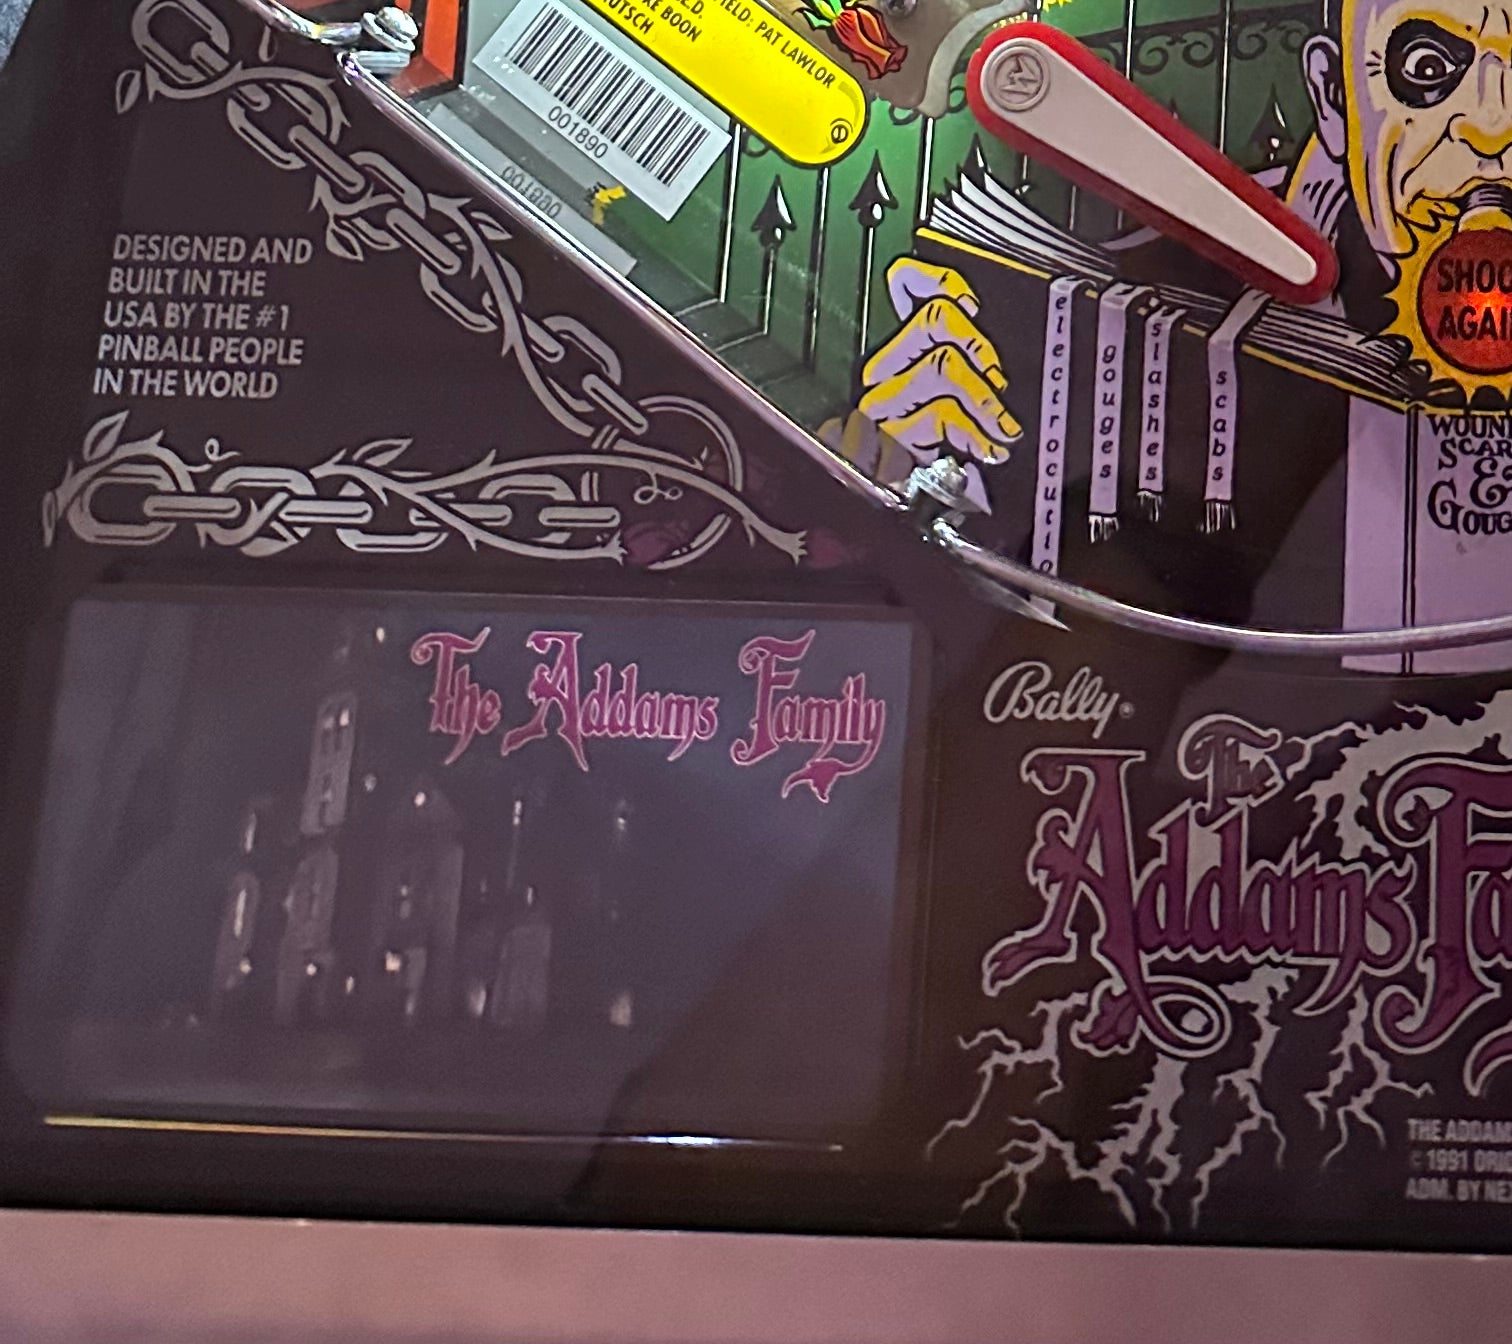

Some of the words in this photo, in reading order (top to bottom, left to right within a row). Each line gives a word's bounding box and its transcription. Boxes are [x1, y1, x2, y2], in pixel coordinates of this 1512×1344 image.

[661, 3, 702, 42] BOON
[755, 20, 782, 46] PAT
[780, 37, 836, 88] LAWLOR
[547, 105, 609, 159] 001890
[113, 234, 247, 262] DESIGNED
[251, 238, 312, 264] AND
[108, 267, 179, 294] BUILT
[182, 270, 211, 295] IN
[218, 270, 266, 297] THE
[104, 301, 158, 328] USA
[164, 303, 197, 329] BY
[202, 303, 250, 330] THE
[256, 304, 289, 331] #1
[98, 334, 204, 363] PINBALL
[209, 336, 304, 365] PEOPLE
[93, 368, 124, 394] IN
[130, 369, 179, 396] THE
[184, 370, 277, 398] WORLD
[1146, 322, 1161, 480] slashes
[1100, 344, 1117, 478] gouges
[1212, 370, 1227, 481] scabs
[410, 626, 500, 765] The
[500, 630, 720, 772] Addams
[730, 628, 886, 803] Family
[984, 661, 1119, 739] Bally
[1178, 713, 1286, 826] The
[981, 746, 1417, 1059] Addams
[1407, 1118, 1442, 1142] THE
[1457, 1179, 1482, 1202] BY
